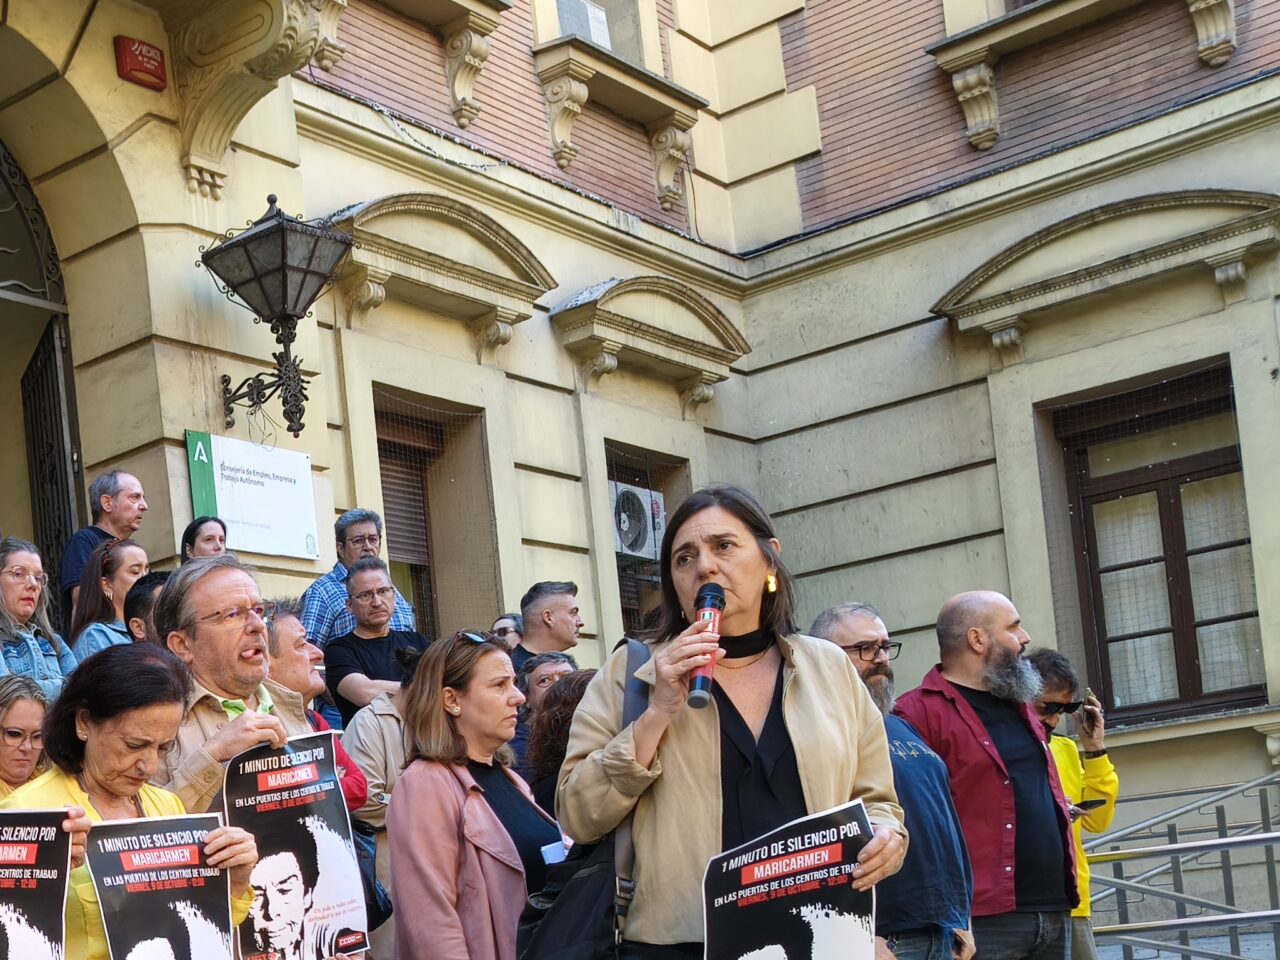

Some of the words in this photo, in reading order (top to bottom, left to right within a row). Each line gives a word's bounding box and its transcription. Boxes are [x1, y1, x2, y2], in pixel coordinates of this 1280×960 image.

[239, 764, 244, 774] 1
[244, 758, 279, 773] MINUTO
[280, 754, 291, 766] DE
[312, 747, 325, 761] POR
[236, 798, 244, 807] EN
[244, 796, 255, 807] LAS
[282, 790, 290, 800] DE
[0, 827, 38, 841] SILENCIO
[39, 827, 56, 841] POR
[97, 840, 104, 853] 1
[104, 836, 141, 852] MINUTO
[142, 833, 155, 849] DE
[155, 831, 193, 846] SILENCIO
[722, 862, 728, 873] 1
[728, 846, 768, 871] MINUTO
[770, 840, 786, 857] DE
[787, 828, 838, 852] SILENCIO
[840, 821, 861, 840] POR
[131, 849, 190, 866] MARICARMEN
[754, 849, 829, 880] MARICARMEN
[23, 869, 32, 879] DE
[32, 870, 58, 879] TRABAJO
[103, 877, 111, 886] EN
[112, 875, 123, 885] LAS
[124, 872, 149, 884] PUERTAS
[150, 871, 158, 881] DE
[158, 871, 169, 881] LOS
[169, 868, 192, 880] CENTROS
[192, 868, 199, 878] DE
[714, 896, 724, 907] EN
[724, 891, 738, 904] LAS
[737, 883, 769, 899] PUERTAS
[770, 879, 780, 891] DE
[780, 876, 795, 888] LOS
[795, 868, 828, 884] CENTROS
[829, 866, 840, 877] DE
